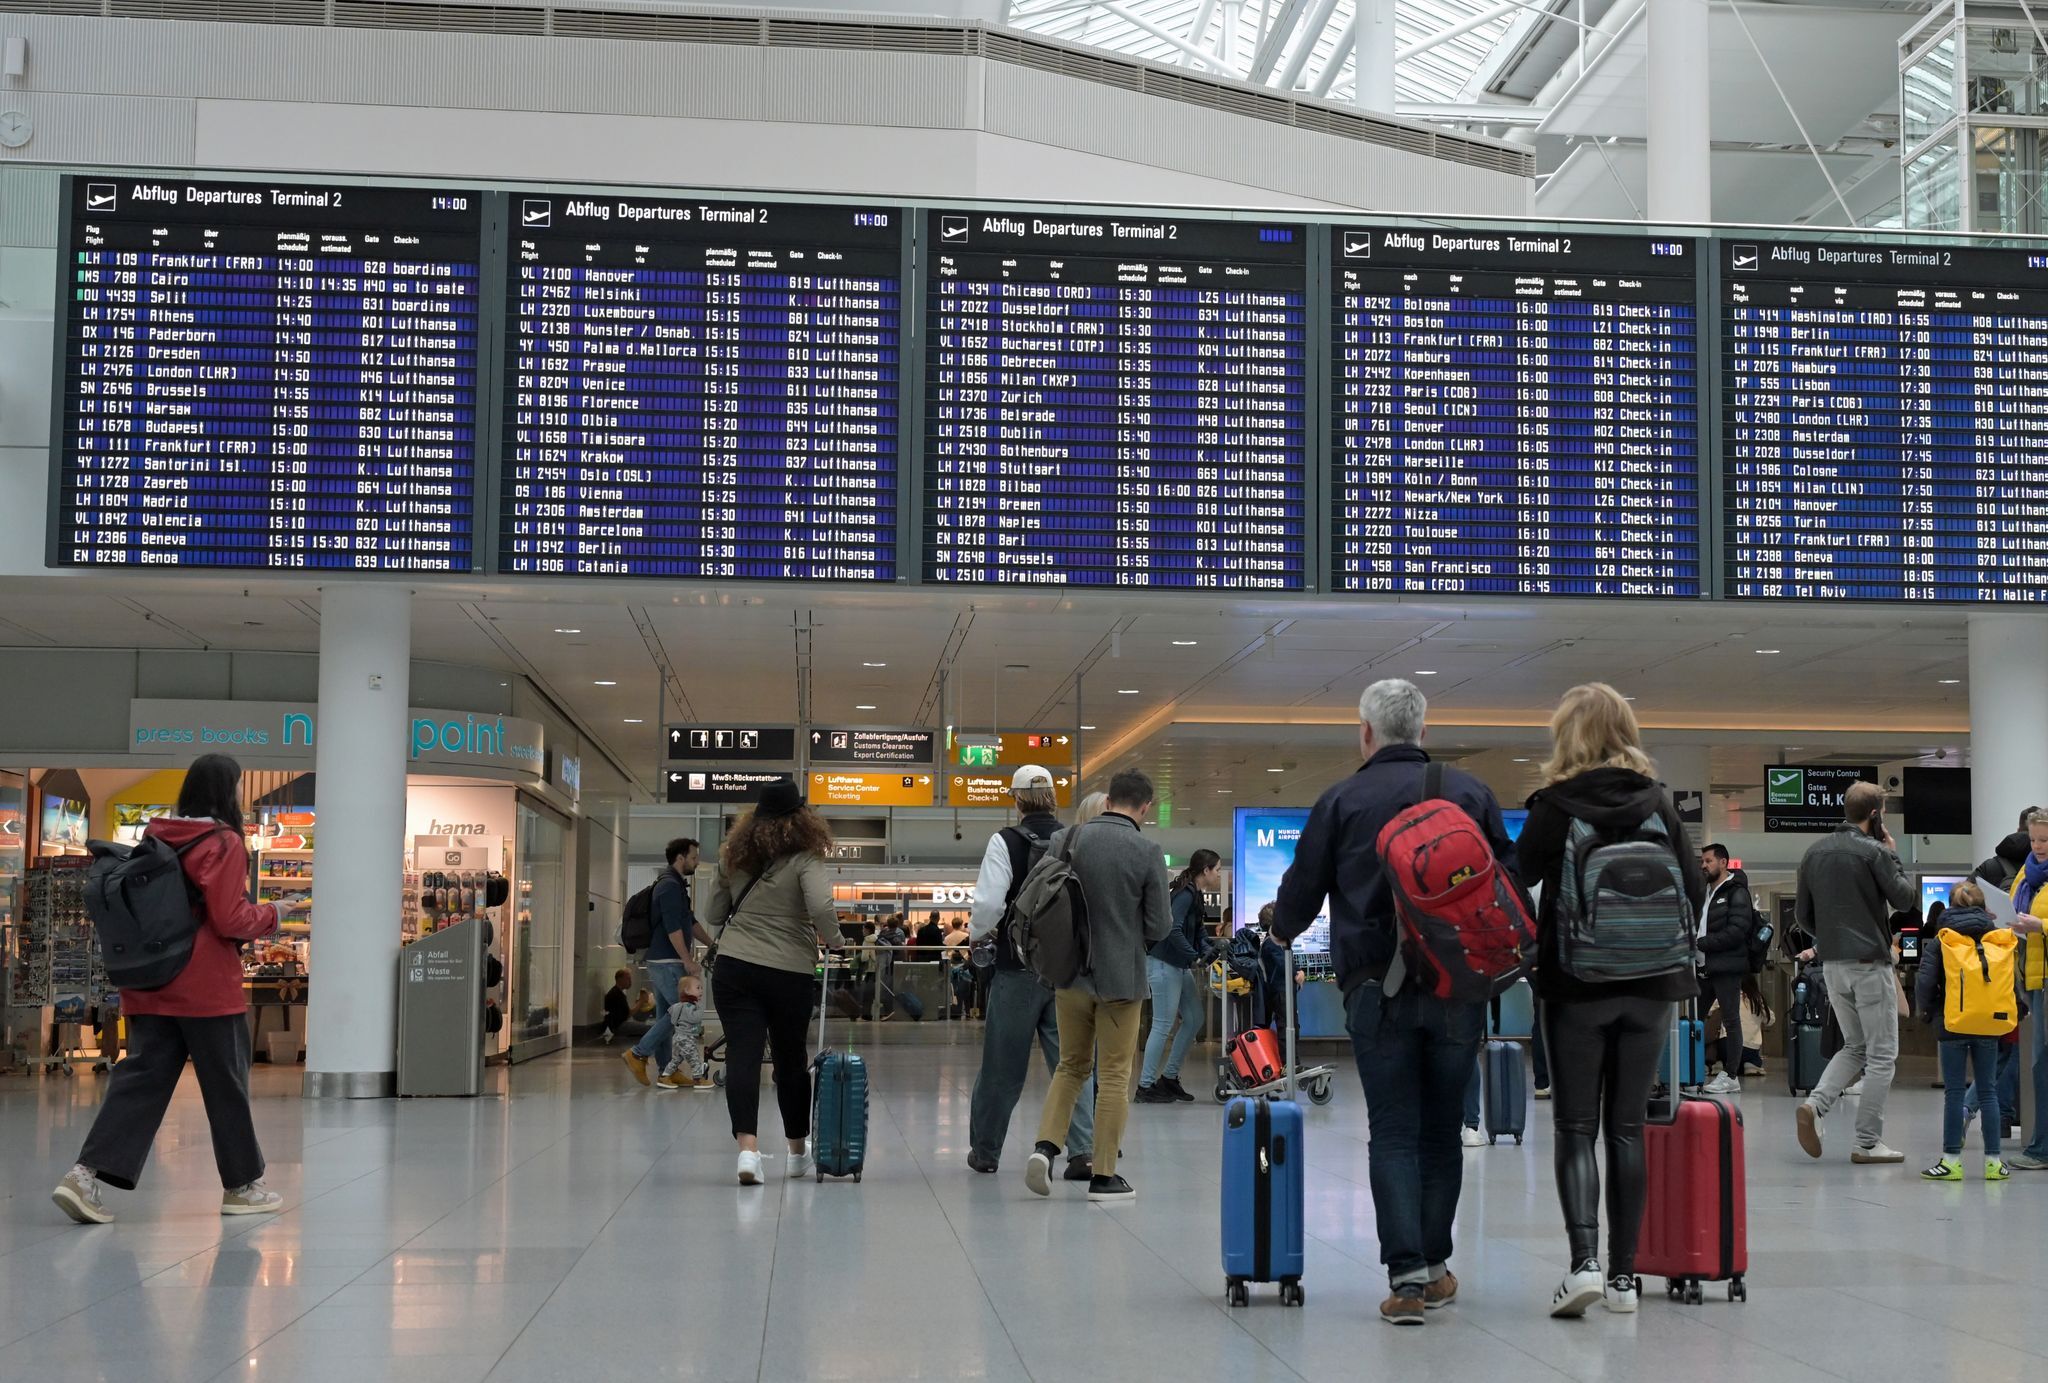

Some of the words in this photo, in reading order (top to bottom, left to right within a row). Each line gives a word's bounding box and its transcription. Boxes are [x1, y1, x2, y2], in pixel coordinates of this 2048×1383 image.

[132, 185, 177, 204] Abflug
[187, 187, 261, 205] Departures
[270, 190, 328, 206] Terminal
[333, 192, 341, 207] 2
[433, 197, 466, 210] 14:00
[566, 201, 609, 220] Abflug
[619, 203, 690, 221] Departures
[699, 206, 754, 223] Terminal
[759, 209, 767, 223] 2
[855, 214, 887, 226] 14:00
[86, 225, 99, 234] Flug
[365, 235, 379, 243] Gate
[983, 218, 1025, 236] Abflug
[1034, 220, 1103, 237] Departures
[1111, 223, 1164, 239] Terminal
[1169, 225, 1176, 239] 2
[86, 236, 103, 245] Flight
[278, 243, 308, 251] scheduled
[321, 245, 351, 253] estimated
[1384, 233, 1424, 251] Abflug
[1433, 235, 1500, 252] Departures
[1507, 237, 1559, 252] Terminal
[1564, 239, 1571, 253] 2
[1652, 244, 1682, 255] 14:00
[1772, 247, 1809, 264] Abflug
[1818, 248, 1882, 264] Departures
[1890, 251, 1939, 265] Terminal
[1944, 253, 1951, 265] 2
[83, 270, 99, 282] MS
[115, 271, 136, 284] 788
[152, 272, 188, 285] Cairo
[278, 277, 312, 289] 14:10
[321, 278, 356, 291] 14:35
[364, 280, 385, 292] H40
[393, 283, 407, 292] go
[416, 281, 428, 293] to
[436, 283, 464, 294] gate
[521, 285, 535, 297] LH
[543, 286, 570, 298] 2462
[585, 287, 640, 301] Helsinki
[707, 292, 740, 304] 15:15
[817, 296, 879, 309] Lufthansa
[84, 307, 98, 319] LH
[107, 308, 135, 320] 1754
[150, 309, 194, 322] Athens
[277, 314, 311, 326] 14:40
[363, 316, 382, 328] K01
[392, 317, 456, 331] Lufthansa
[1345, 314, 1357, 325] LH
[1371, 315, 1391, 326] 424
[1404, 316, 1443, 328] Boston
[1517, 319, 1548, 331] 16:00
[1593, 321, 1611, 333] L21
[1619, 322, 1670, 335] Check-in
[1734, 326, 1747, 337] LH
[1754, 326, 1778, 338] 1948
[1792, 327, 1829, 339] Berlin
[1900, 331, 1929, 343] 17:00
[1998, 334, 2047, 346] Lufthans
[82, 344, 96, 356] LH
[104, 345, 133, 358] 2126
[149, 346, 200, 360] Dresden
[276, 350, 310, 363] 14:50
[362, 353, 383, 365] K12
[391, 354, 455, 367] Lufthansa
[939, 407, 952, 418] LH
[961, 407, 987, 420] 1736
[1001, 409, 1055, 422] Belgrade
[1118, 412, 1150, 425] 15:40
[1198, 415, 1218, 426] H48
[1225, 416, 1284, 428] Lufthansa
[939, 425, 952, 436] LH
[960, 425, 986, 437] 2518
[1001, 427, 1041, 439] Dublin
[1118, 430, 1150, 442] 15:40
[1198, 432, 1217, 444] H38
[1225, 433, 1284, 446] Lufthansa
[1345, 454, 1358, 465] LH
[1365, 454, 1391, 466] 2264
[1405, 455, 1463, 468] Marseille
[1518, 458, 1549, 470] 16:05
[1595, 460, 1614, 472] K12
[1621, 461, 1672, 473] Check-in
[514, 559, 527, 570] LH
[536, 559, 563, 571] 1906
[578, 560, 627, 573] Catania
[701, 563, 734, 575] 15:30
[812, 566, 874, 579] Lufthansa
[1738, 584, 1750, 596] LH
[1763, 585, 1782, 596] 682
[1795, 585, 1812, 597] Tel
[1821, 586, 1846, 597] Aviv
[1905, 588, 1934, 599] 18:15
[1979, 589, 1996, 600] F21
[2004, 589, 2034, 601] Halle
[136, 728, 193, 744] press
[200, 727, 270, 744] books
[854, 733, 928, 742] Zollabfertigung/Ausfuhr
[1808, 770, 1835, 778] Security
[1808, 793, 1820, 806] G,
[1822, 794, 1834, 806] H,
[430, 819, 485, 834] hama
[1257, 829, 1274, 847] M
[447, 853, 459, 862] Go
